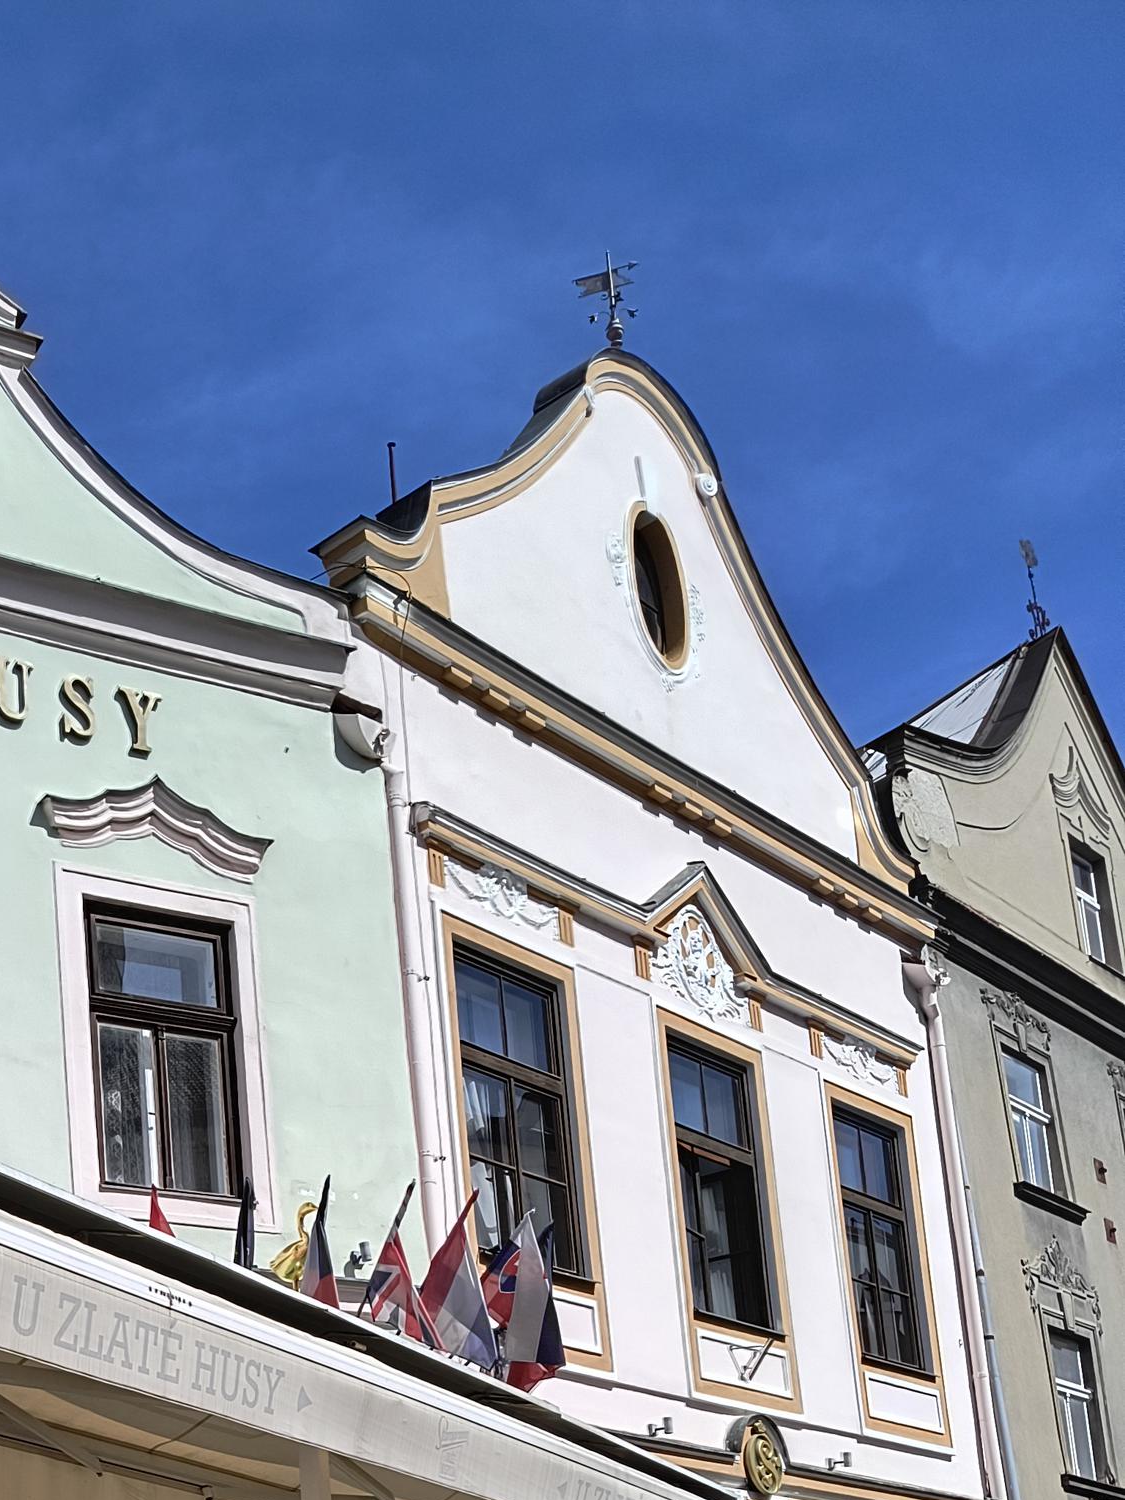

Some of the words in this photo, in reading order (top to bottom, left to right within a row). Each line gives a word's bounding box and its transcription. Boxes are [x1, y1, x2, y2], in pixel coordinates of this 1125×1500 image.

[13, 1275, 45, 1337] U
[53, 1293, 183, 1385] ZLATÉ
[191, 1340, 285, 1415] HUSY
